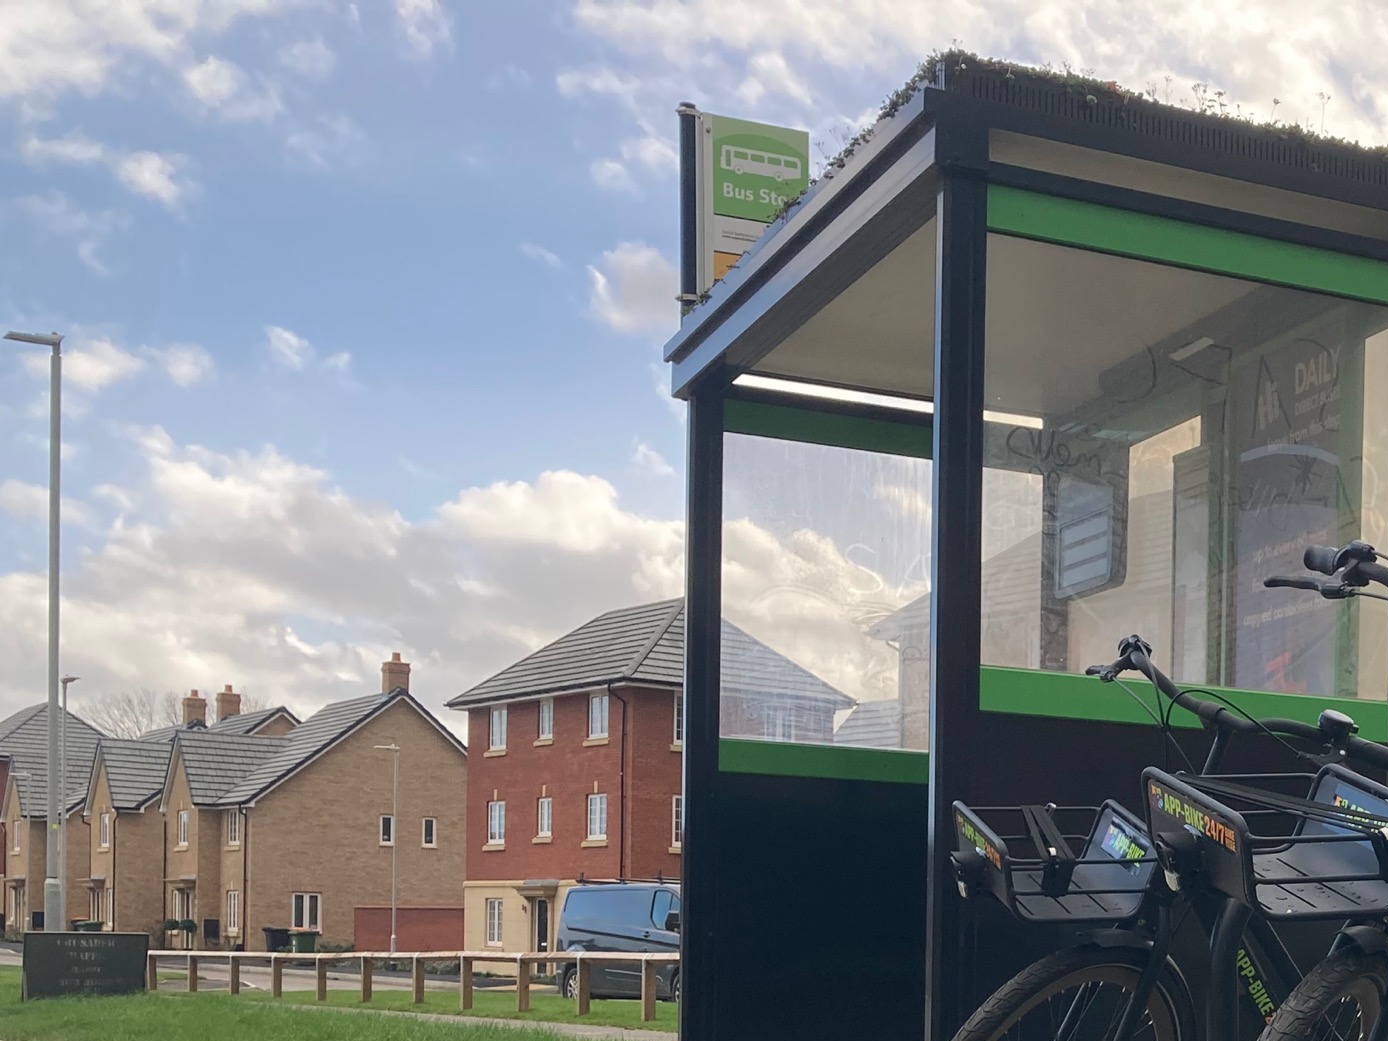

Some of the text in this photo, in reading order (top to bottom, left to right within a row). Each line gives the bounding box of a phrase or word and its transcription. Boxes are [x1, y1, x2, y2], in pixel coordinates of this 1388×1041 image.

[723, 182, 788, 206] Bus Sto
[1294, 345, 1341, 394] DAILY
[1257, 380, 1280, 431] Hi
[1164, 793, 1225, 845] APP-BIKE 24/7
[1237, 949, 1275, 1016] APP-BIKE
